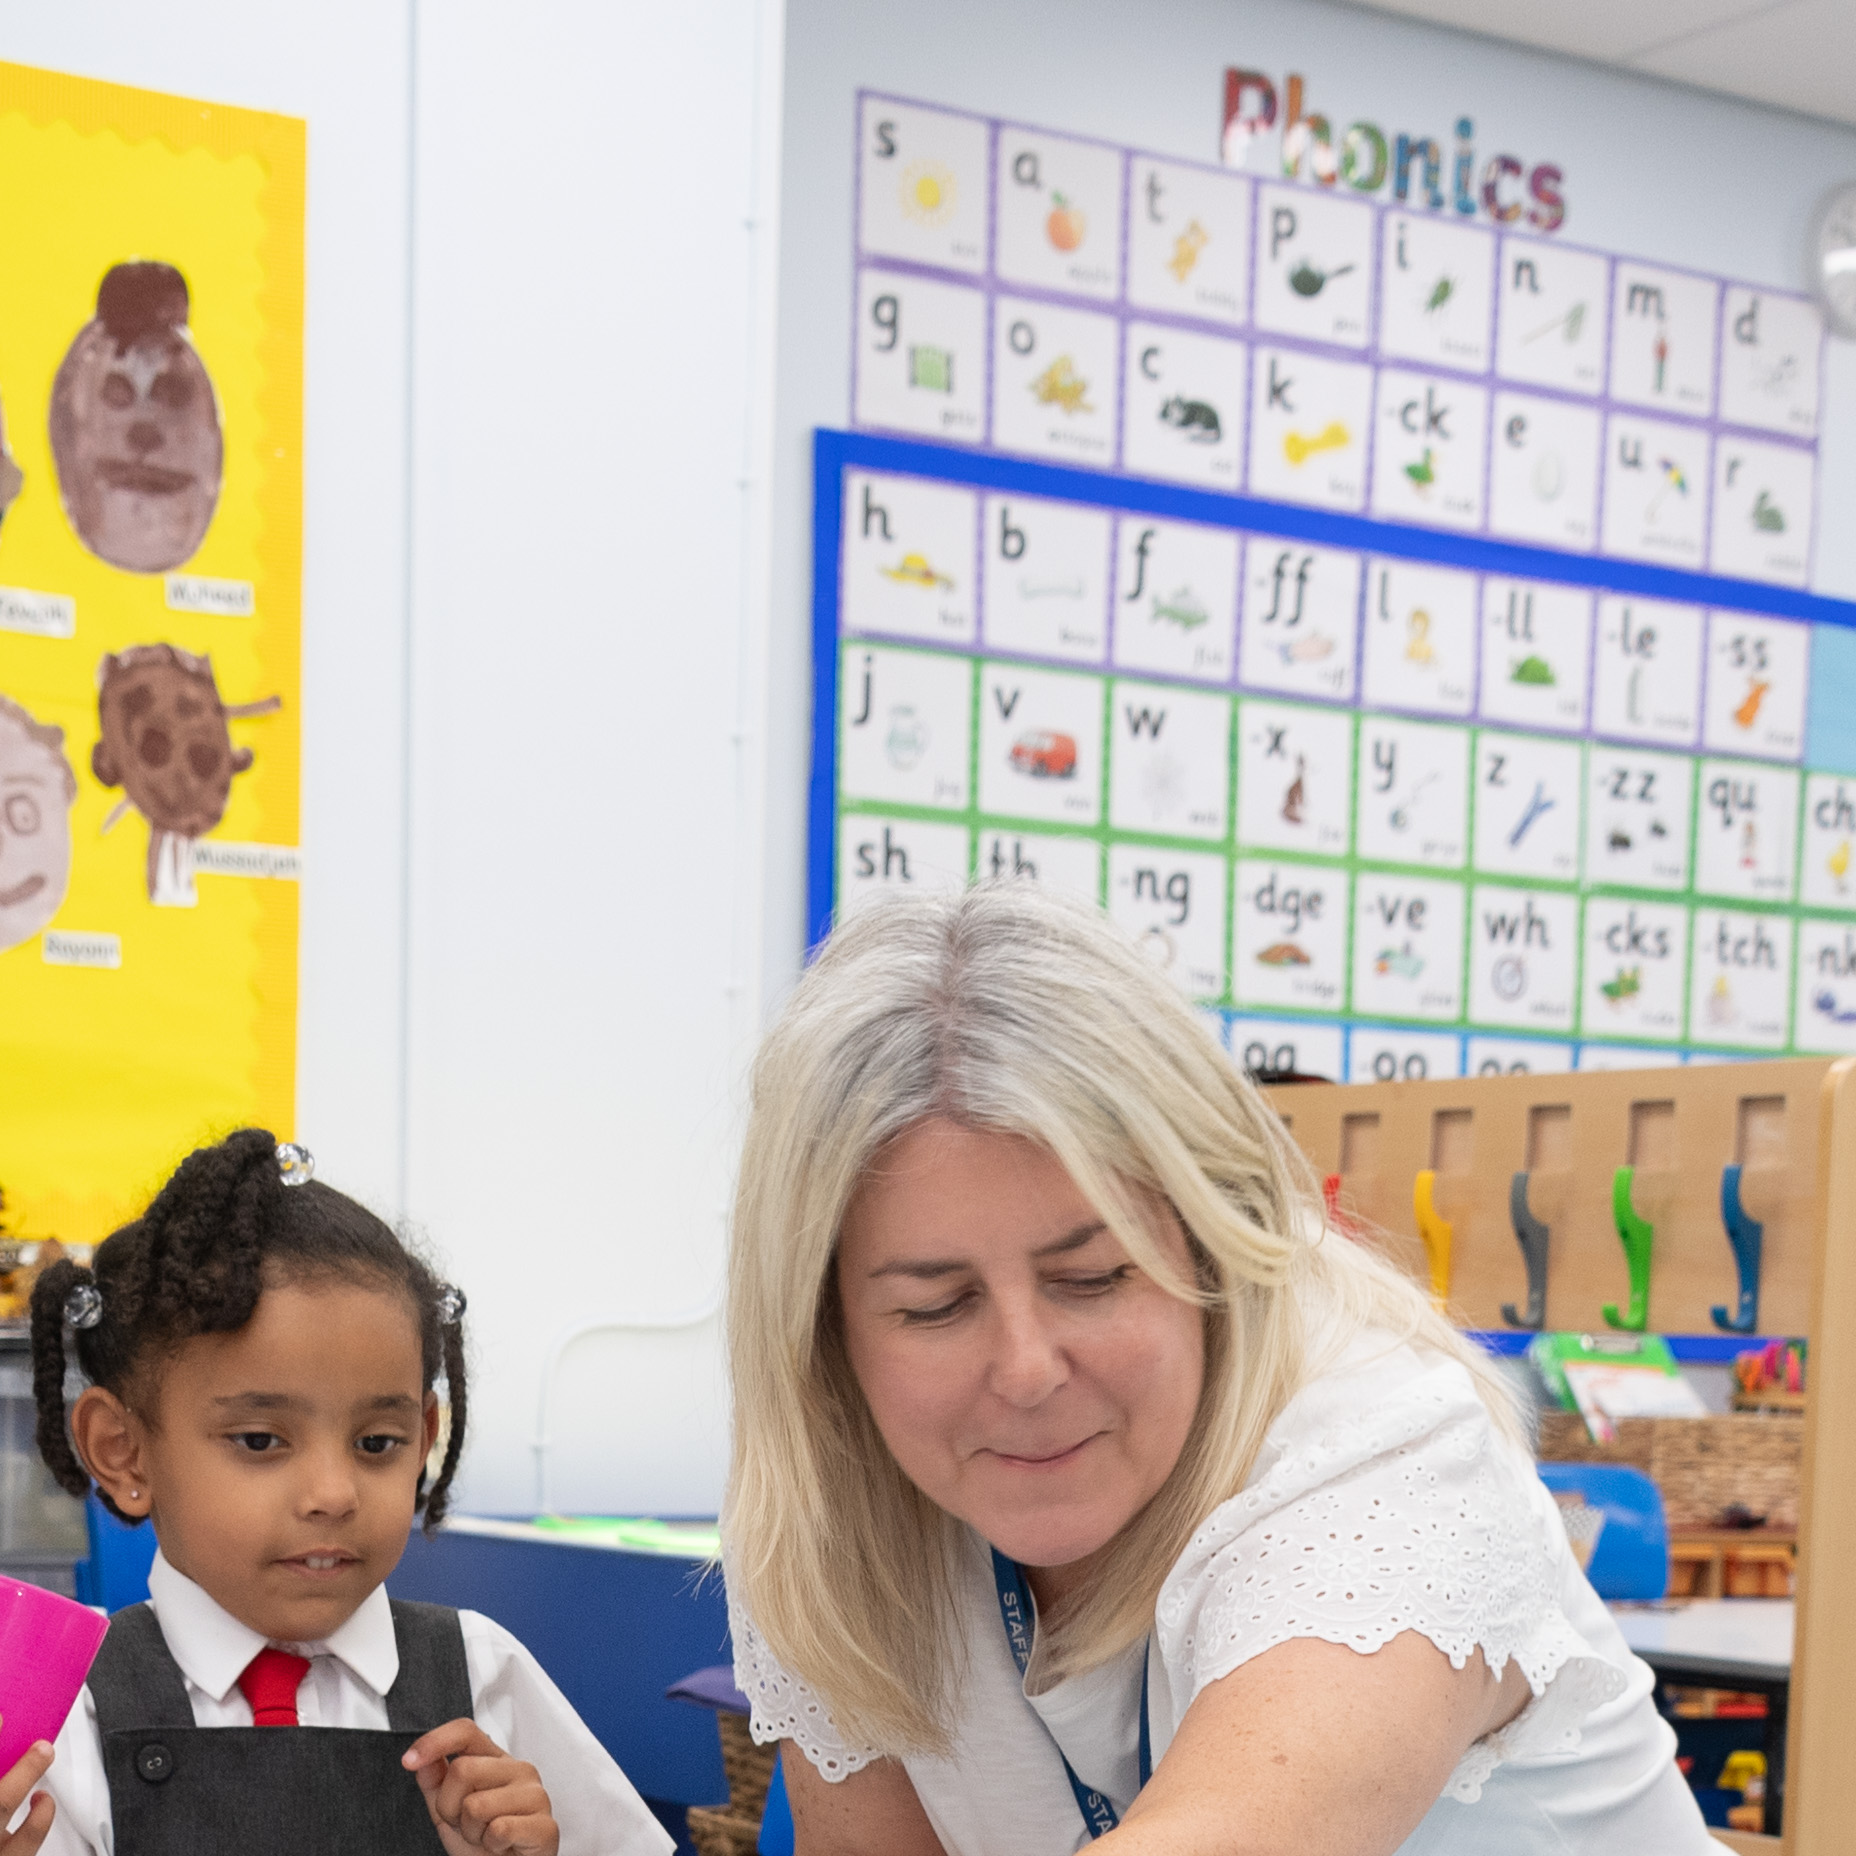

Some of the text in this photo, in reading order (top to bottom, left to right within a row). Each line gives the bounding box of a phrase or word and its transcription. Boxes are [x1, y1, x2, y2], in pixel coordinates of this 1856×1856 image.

[875, 120, 896, 158] s
[1222, 66, 1567, 234] Phonics
[1013, 152, 1042, 191] a
[1146, 173, 1164, 223] t
[1271, 207, 1297, 260] p
[1513, 257, 1539, 293] n
[872, 295, 898, 352] g
[1628, 280, 1667, 320] m
[1734, 287, 1758, 346] d
[1009, 321, 1034, 355] o
[1141, 346, 1160, 381] c
[1268, 357, 1295, 413] k
[1506, 413, 1528, 448] e
[1620, 435, 1645, 471] u
[862, 485, 893, 542] h
[1000, 507, 1026, 561] b
[1127, 530, 1156, 601] f
[854, 656, 874, 726] j
[995, 687, 1020, 721] v
[1126, 706, 1167, 741] w
[1374, 739, 1396, 792] y
[1486, 753, 1508, 786] z
[1709, 777, 1757, 826] qu
[856, 826, 912, 882] sh
[1485, 901, 1552, 949] wh
[1004, 1591, 1029, 1664] STAFF
